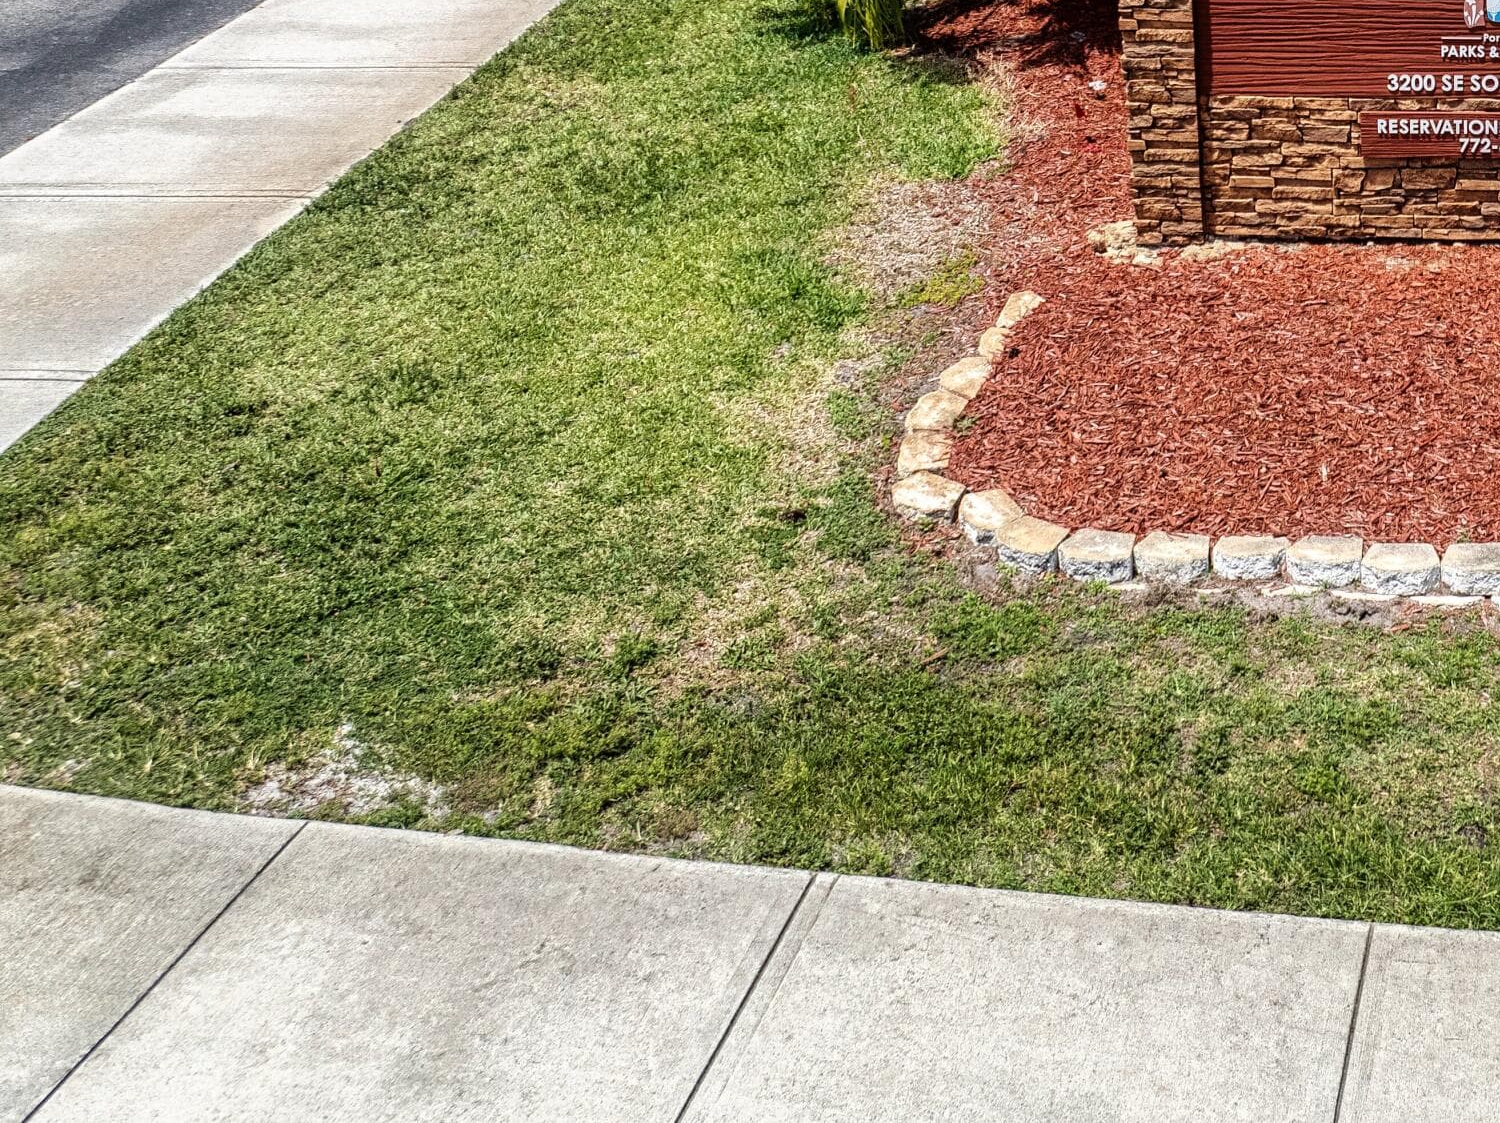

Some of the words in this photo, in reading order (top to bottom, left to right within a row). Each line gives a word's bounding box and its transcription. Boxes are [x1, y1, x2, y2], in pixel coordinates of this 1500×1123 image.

[1440, 45, 1485, 58] PARKS
[1489, 46, 1499, 58] &
[1386, 74, 1436, 92] 3200
[1441, 75, 1463, 92] SE
